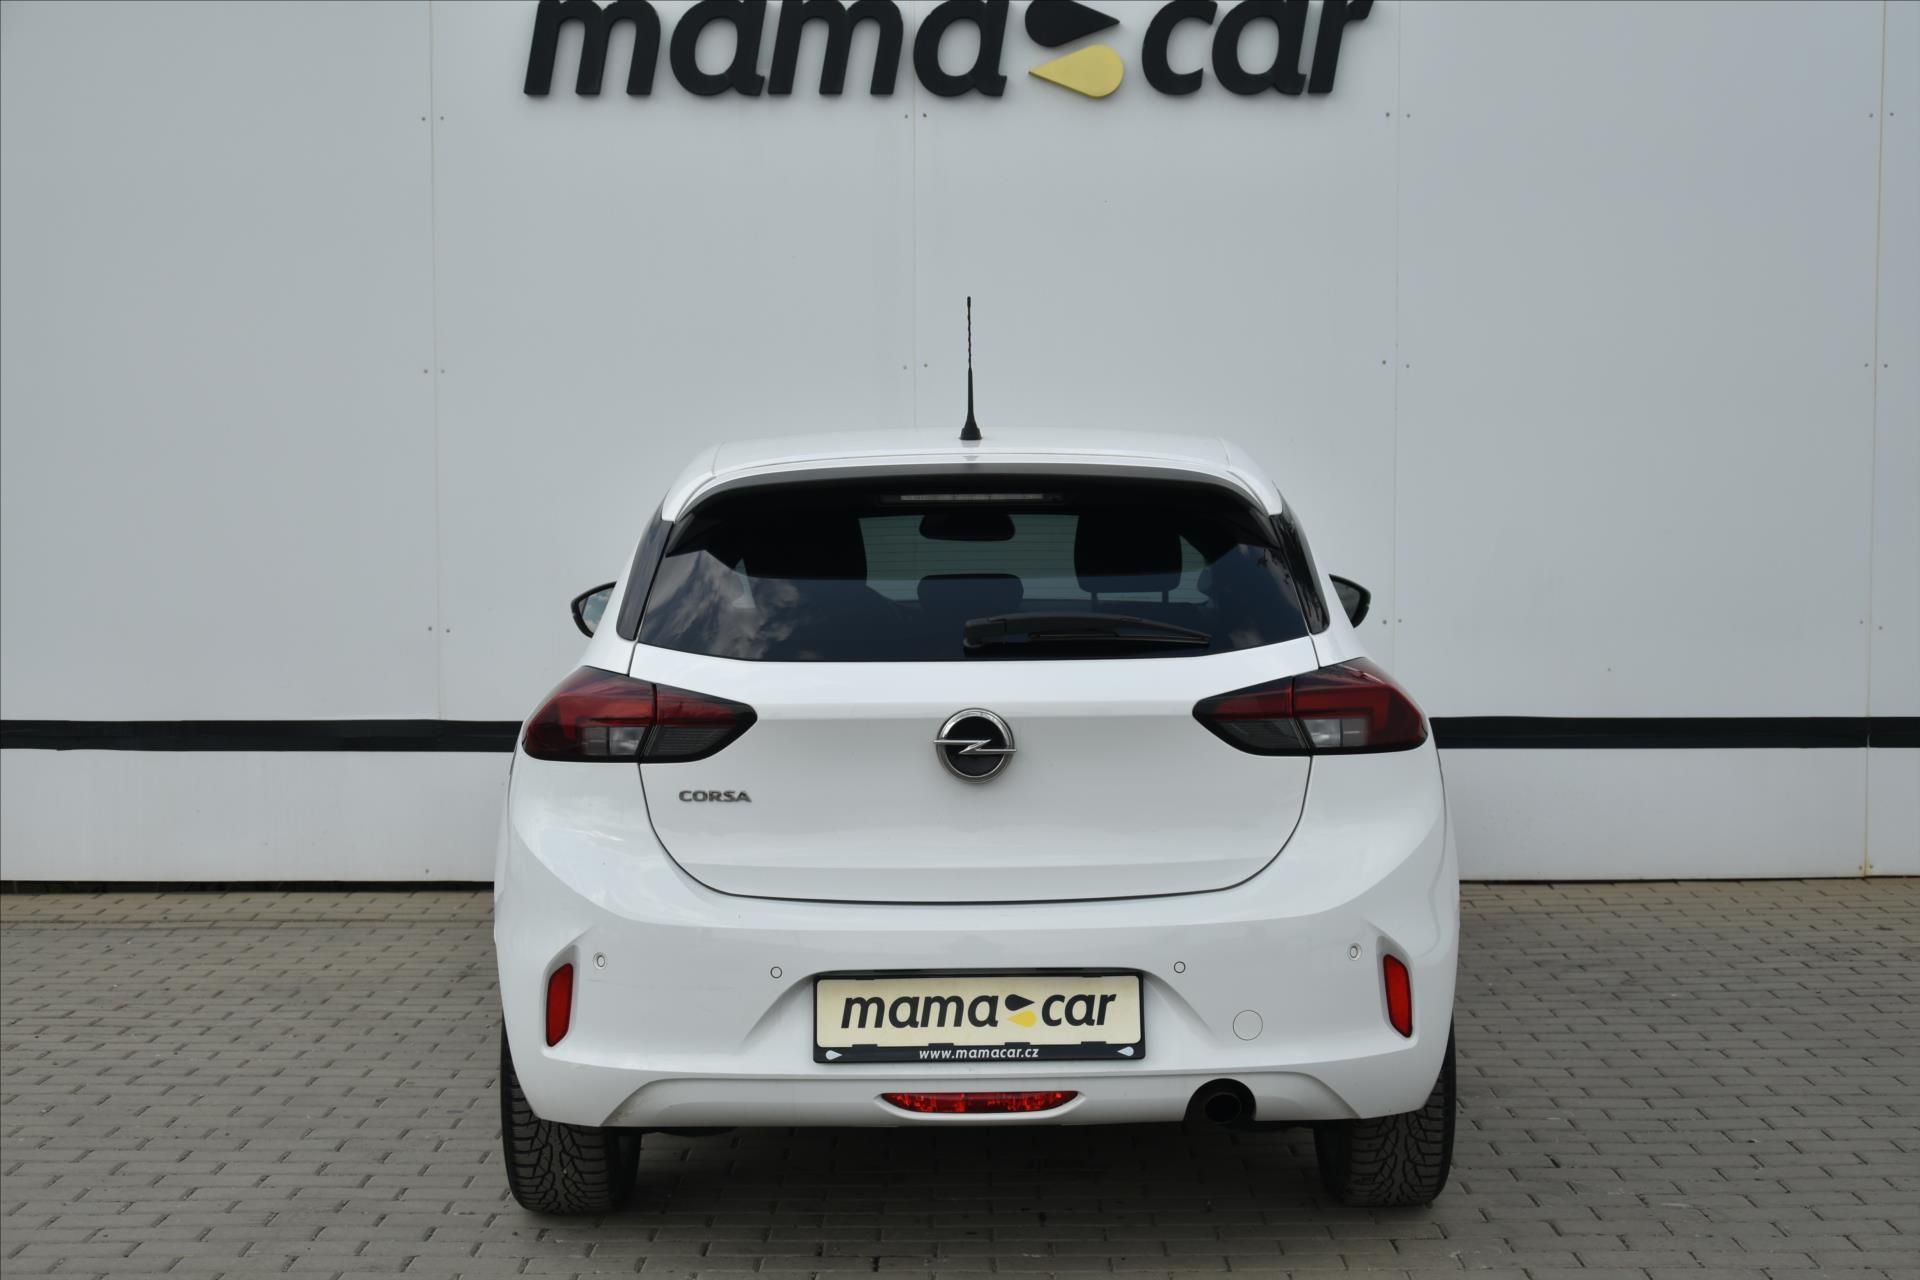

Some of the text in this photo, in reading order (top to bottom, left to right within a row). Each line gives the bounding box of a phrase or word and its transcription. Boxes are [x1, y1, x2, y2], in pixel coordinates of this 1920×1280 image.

[523, 0, 1374, 98] mama car
[679, 790, 752, 803] CORSA
[841, 993, 1117, 1029] mama car
[919, 1046, 1040, 1060] www.mamacar.cz
